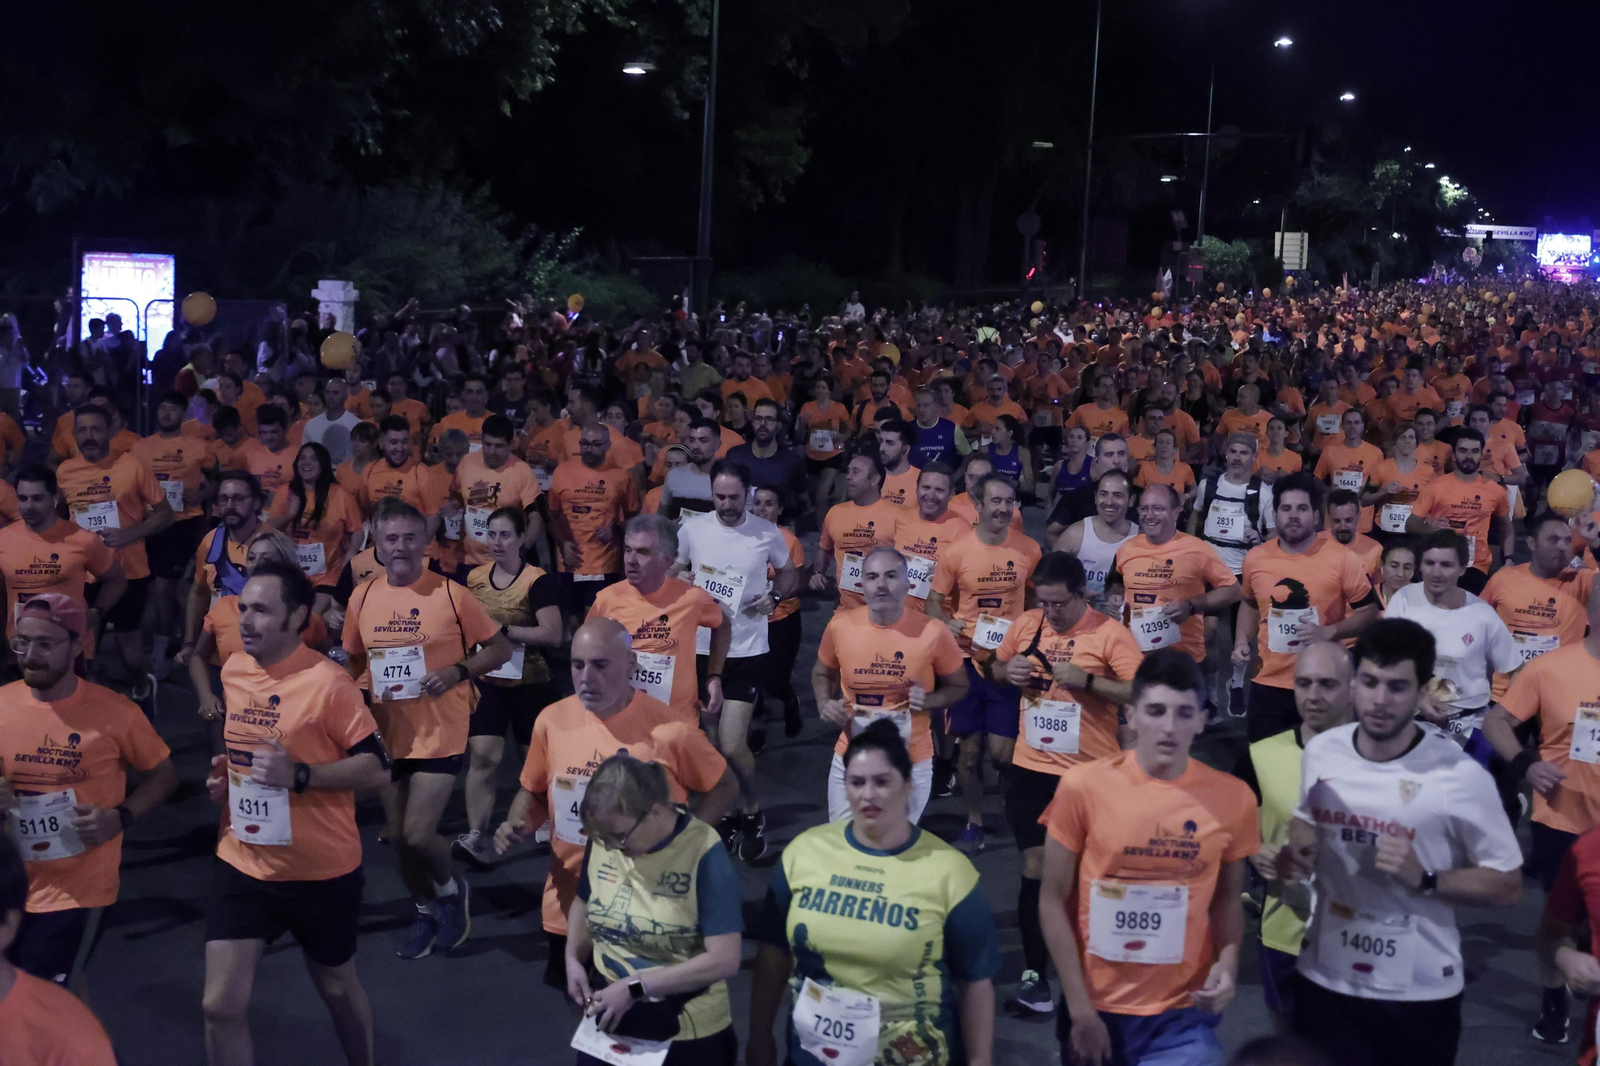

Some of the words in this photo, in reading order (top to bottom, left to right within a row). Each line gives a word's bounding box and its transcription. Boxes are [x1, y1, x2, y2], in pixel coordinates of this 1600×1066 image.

[1339, 479, 1357, 487] 16443
[87, 515, 107, 527] 7391
[1216, 516, 1234, 526] 2831
[1389, 513, 1406, 522] 6282
[849, 566, 863, 578] 20
[907, 568, 927, 583] 6842
[704, 579, 734, 598] 10365
[1514, 608, 1541, 617] SEVILLA
[637, 626, 671, 634] NOCTURNA
[1140, 618, 1170, 634] 12395
[1519, 649, 1549, 660] 1267
[383, 664, 411, 679] 4774
[853, 668, 886, 676] SEVILLA
[870, 662, 906, 670] NOCTURNA
[629, 668, 663, 685] 1555
[229, 713, 258, 725] SEVILLA
[243, 707, 281, 719] NOCTURNA
[1033, 715, 1068, 732] 13888
[36, 746, 83, 758] NOCTURNA
[14, 753, 55, 766] SEVILLA
[565, 766, 593, 777] SEVIL
[238, 797, 269, 817] 4311
[19, 815, 60, 835] 5118
[1310, 806, 1417, 841] MARATHON
[1341, 827, 1379, 846] BET
[1148, 837, 1201, 850] NOCTURNA
[1122, 845, 1170, 858] SEVILLA
[829, 873, 885, 894] RUNNERS
[797, 885, 921, 932] BARREÑOS
[1114, 910, 1162, 931] 9889
[1340, 928, 1397, 958] 14005
[813, 1013, 856, 1042] 7205
